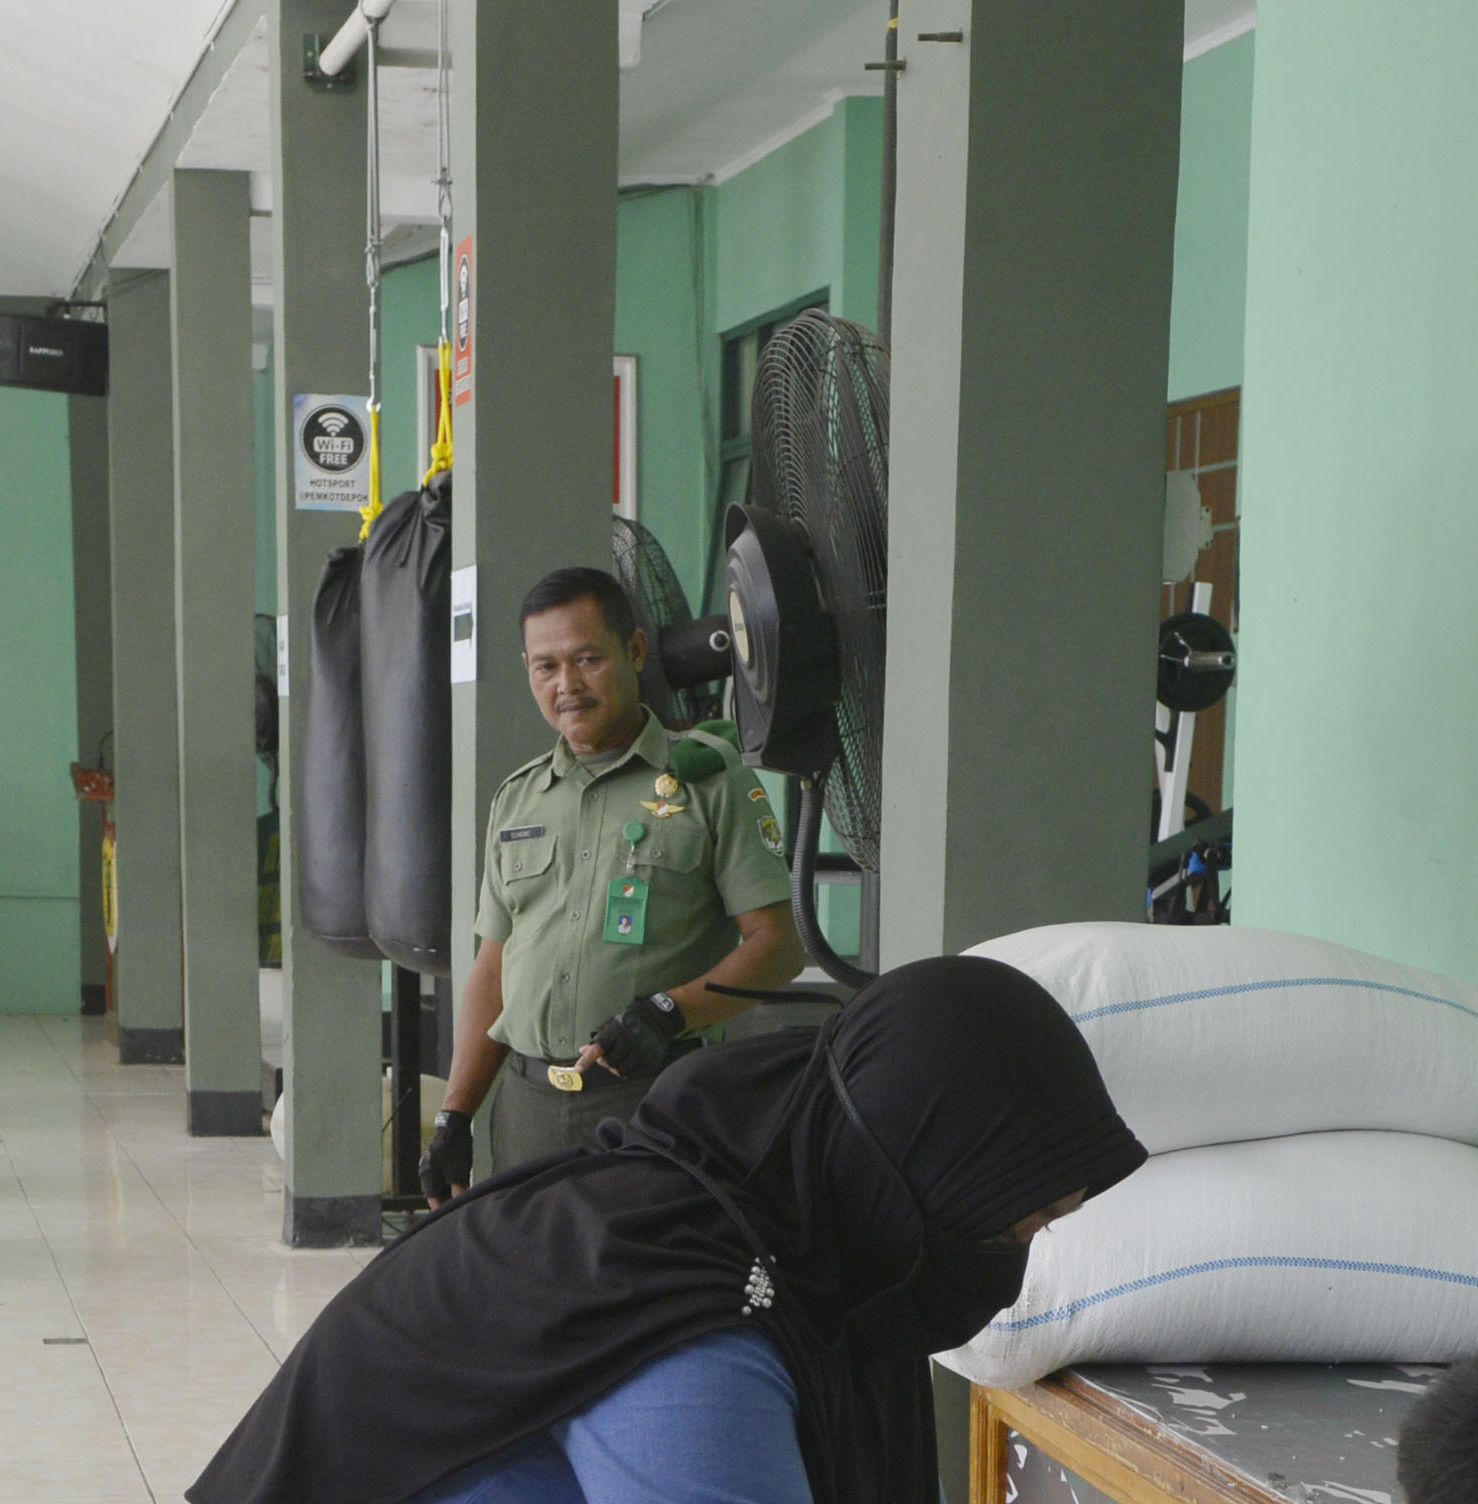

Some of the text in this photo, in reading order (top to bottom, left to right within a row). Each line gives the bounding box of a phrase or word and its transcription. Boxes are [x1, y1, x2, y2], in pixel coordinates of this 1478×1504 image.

[317, 439, 351, 451] Wi-Fi
[319, 453, 348, 465] FREE
[309, 480, 355, 488] HOTSPORT
